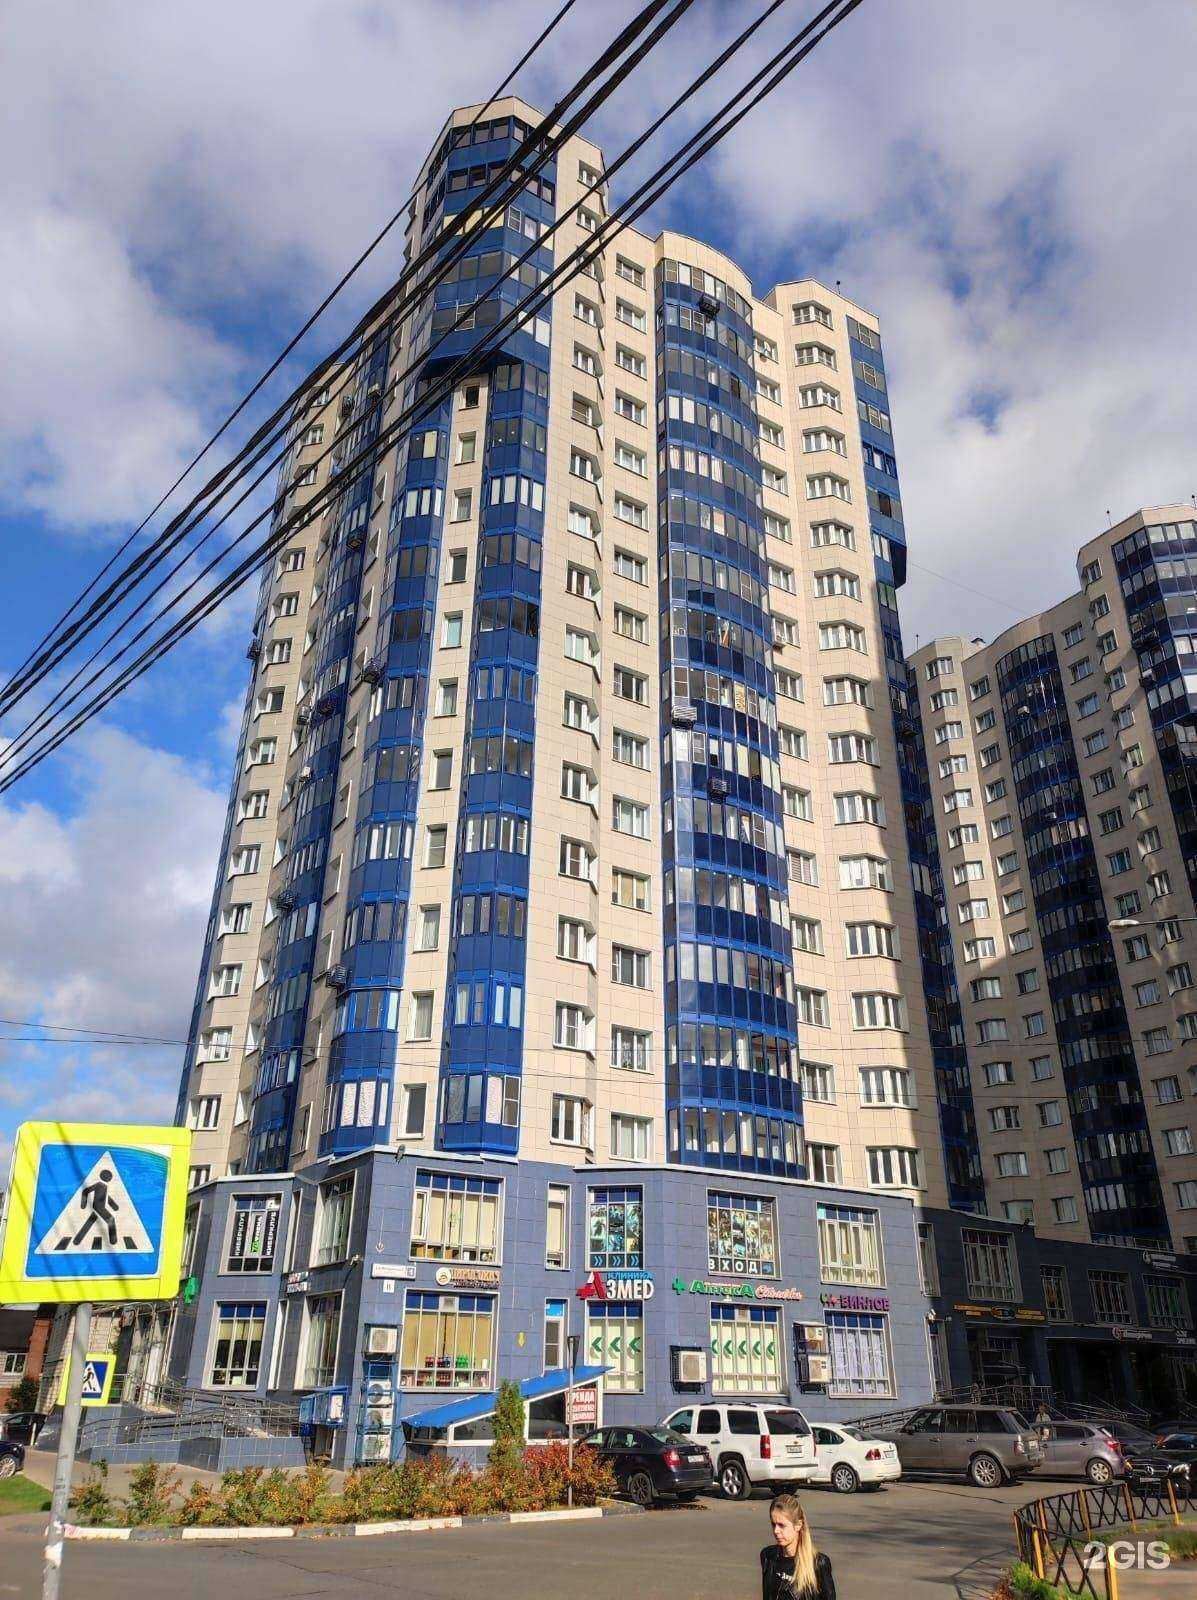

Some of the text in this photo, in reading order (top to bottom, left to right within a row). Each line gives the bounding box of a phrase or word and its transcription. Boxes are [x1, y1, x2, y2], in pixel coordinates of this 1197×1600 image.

[234, 1212, 246, 1256] КИБЕРКЛУБ
[266, 1211, 277, 1256] КИБЕРКЛУБ
[607, 1271, 655, 1280] КЛИНИКА
[708, 1257, 758, 1274] ВХОД
